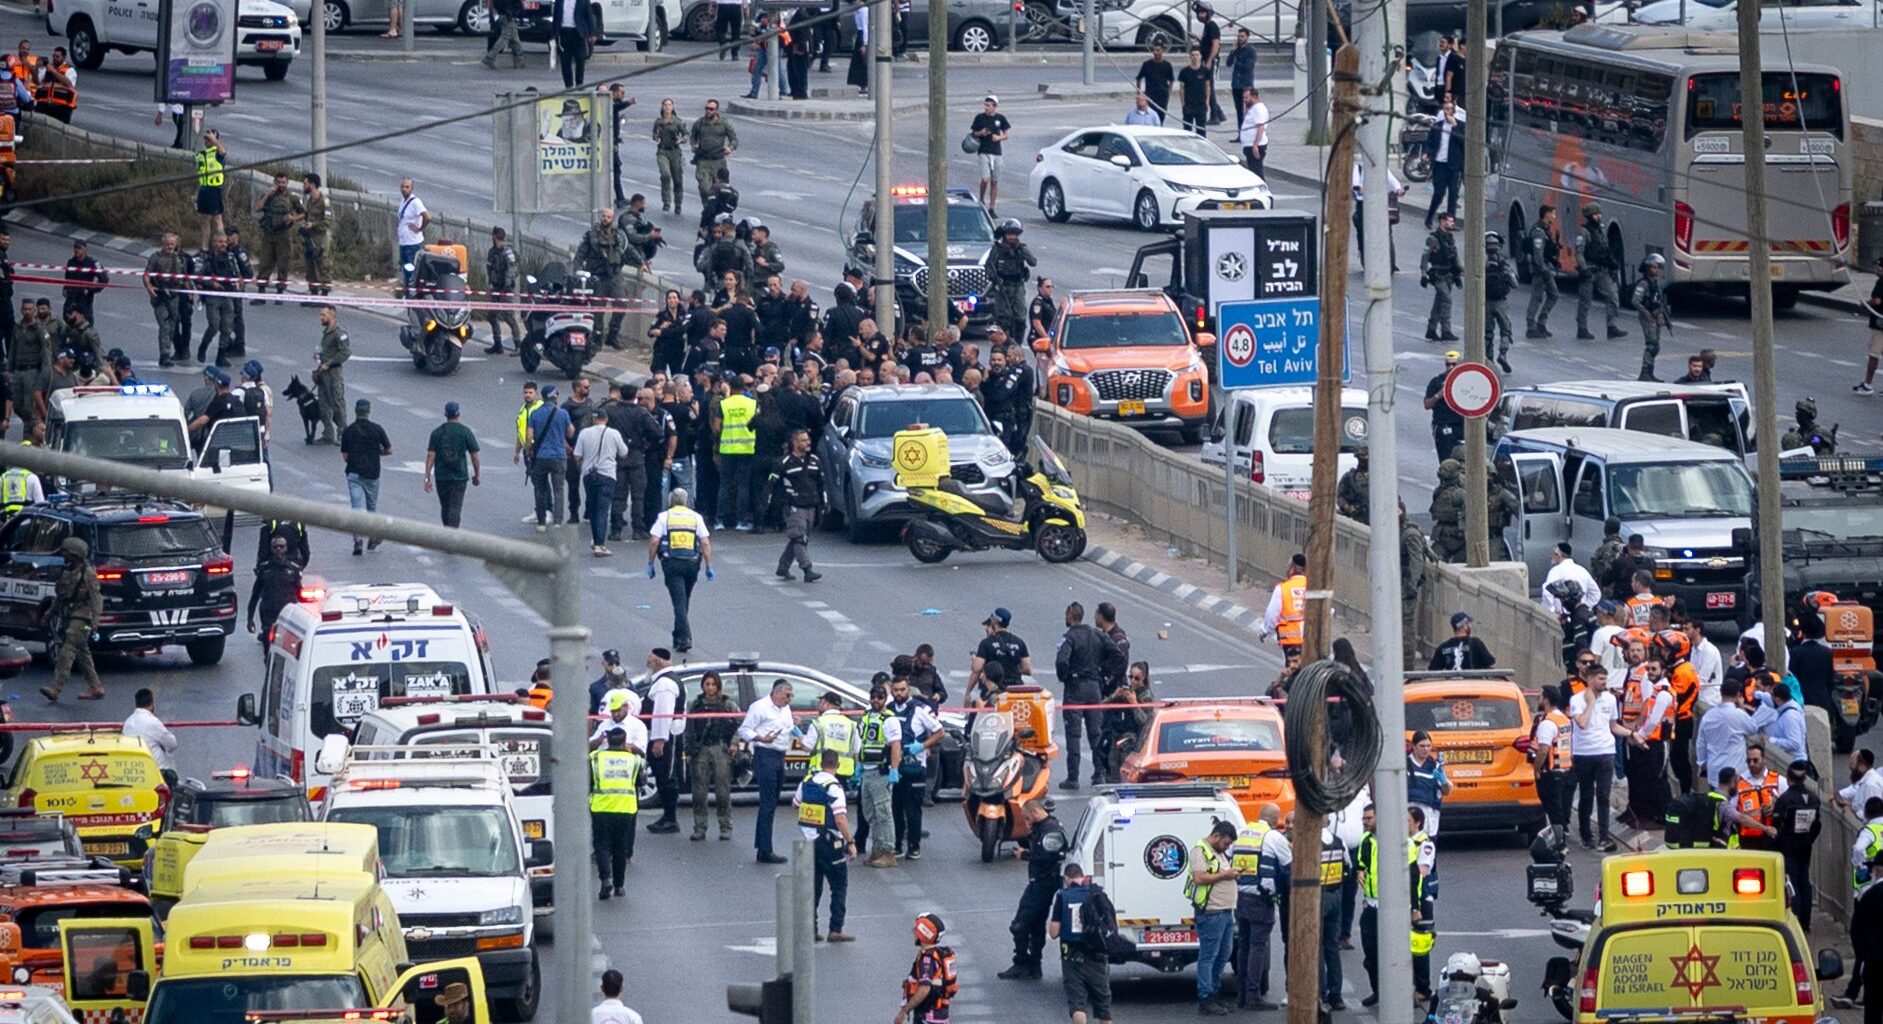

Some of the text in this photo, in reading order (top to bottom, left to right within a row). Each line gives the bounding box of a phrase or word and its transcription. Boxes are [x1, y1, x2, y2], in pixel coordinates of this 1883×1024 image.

[108, 6, 133, 19] POLICE
[542, 147, 577, 160] המלך
[1266, 239, 1300, 252] את"ל
[1272, 258, 1298, 279] לב
[1265, 280, 1304, 293] הבירה
[1254, 309, 1314, 328] תל אביב
[1232, 336, 1250, 354] 4.8
[1263, 332, 1307, 355] تل أبيب
[1257, 356, 1313, 374] Tel Aviv
[785, 761, 807, 771] LICE
[1656, 902, 1726, 917] פראמדיק
[222, 957, 292, 970] פראמדיק
[1613, 954, 1653, 969] MAGEN
[1731, 951, 1777, 965] מגן דוד
[1613, 965, 1648, 979] DAVID
[1745, 965, 1778, 978] אדום
[1613, 975, 1648, 988] ADOM
[1726, 976, 1778, 992] בישראל
[1613, 983, 1665, 995] IN ISRAEL
